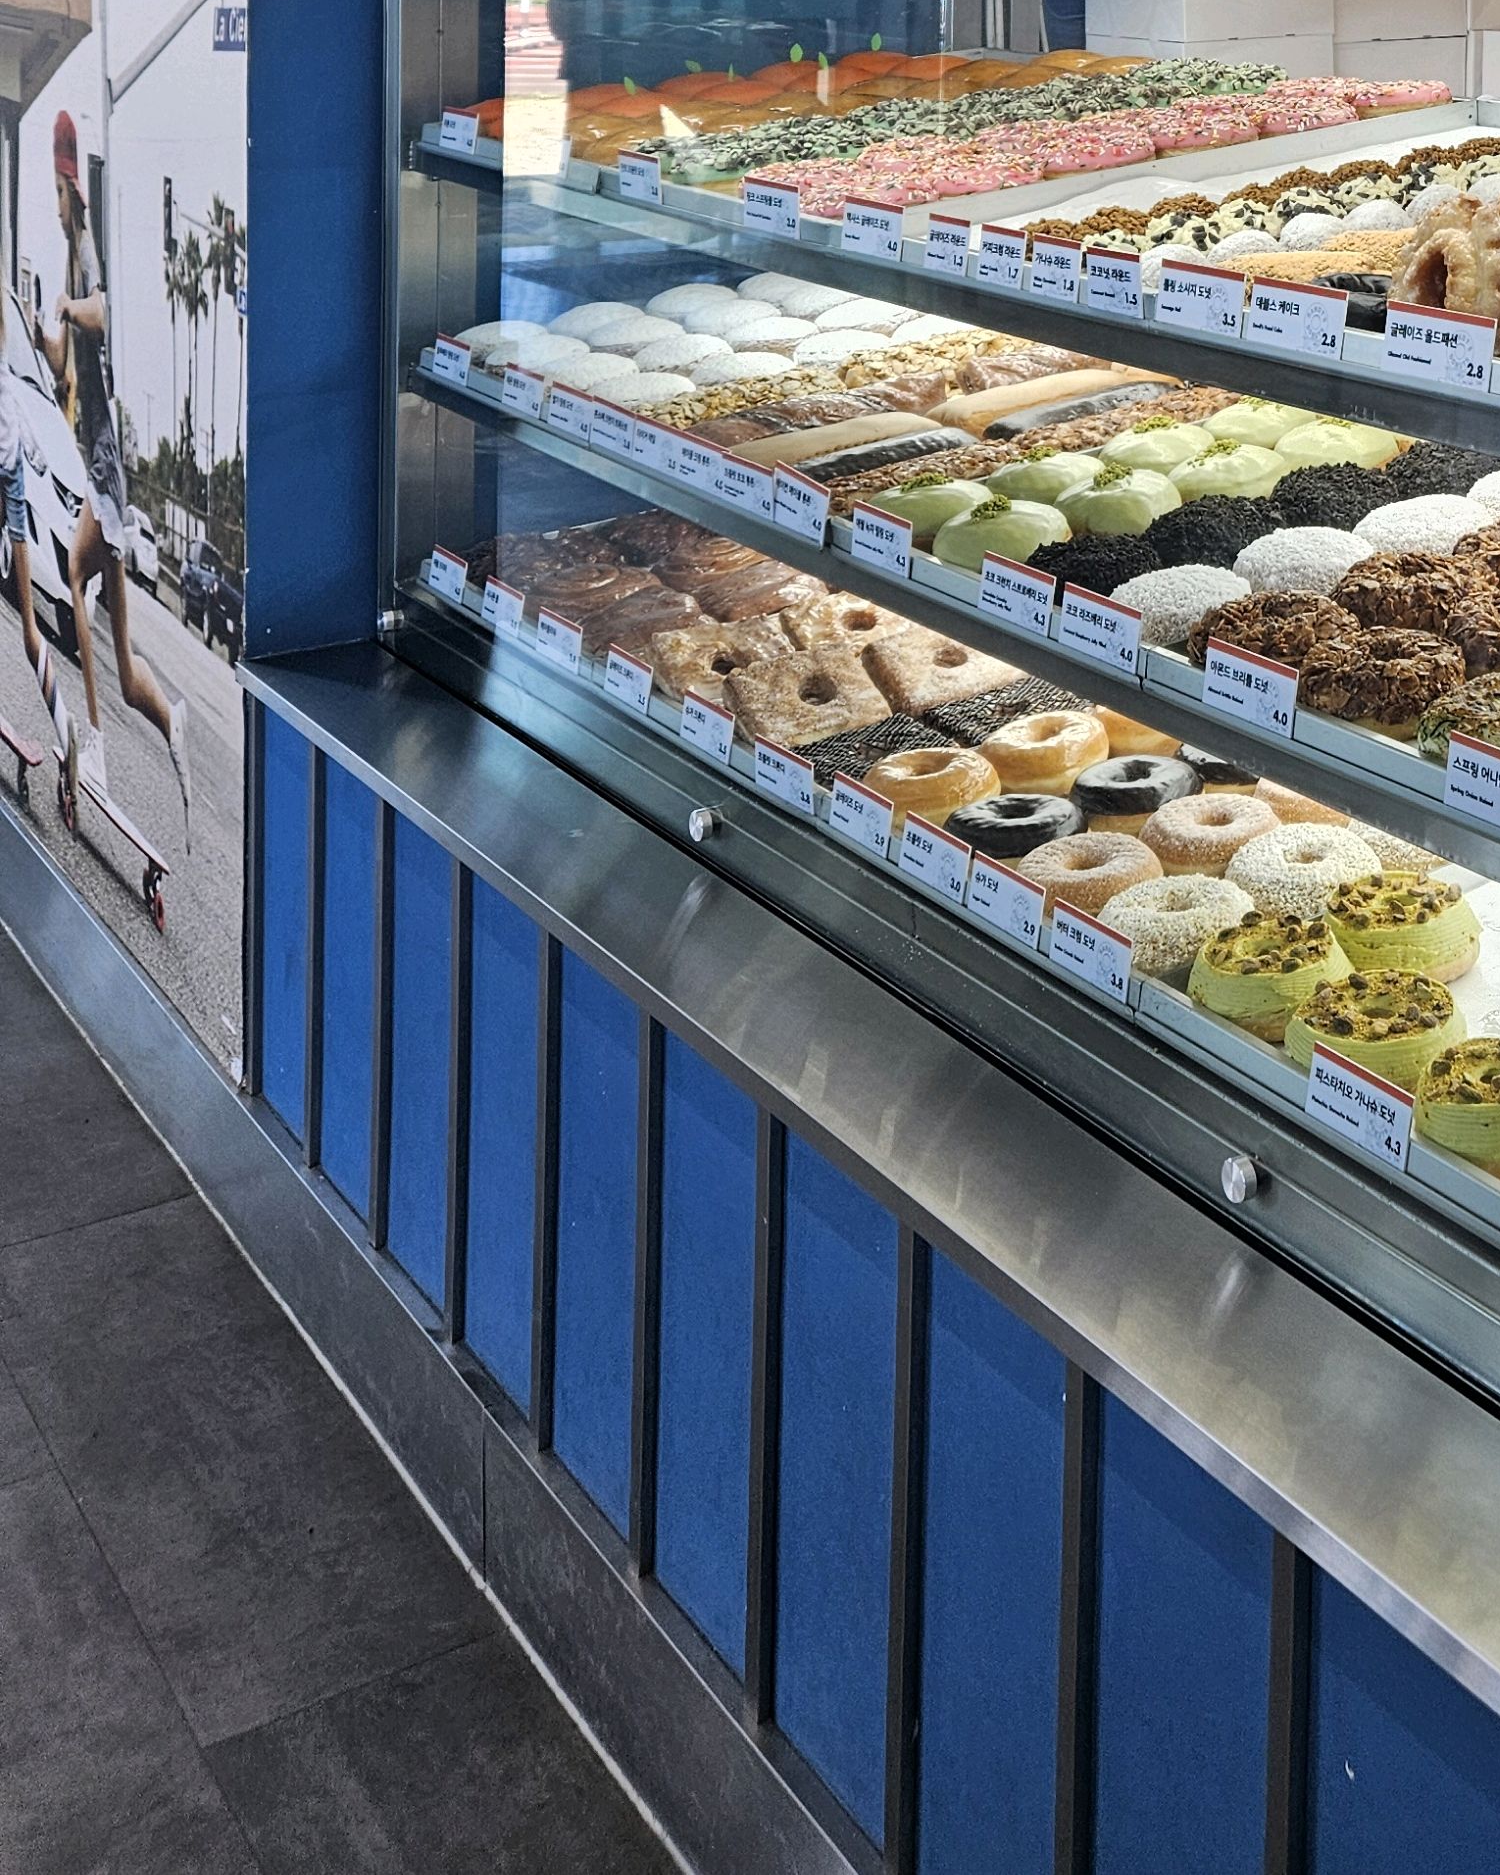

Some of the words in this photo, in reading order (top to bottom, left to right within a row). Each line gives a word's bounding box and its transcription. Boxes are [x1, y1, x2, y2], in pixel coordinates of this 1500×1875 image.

[950, 234, 966, 247] 라운드
[1004, 247, 1021, 259] 라운드
[1035, 252, 1054, 267] 가나슈
[1054, 256, 1071, 270] 라운드
[1090, 265, 1110, 280] 코코넛
[1111, 268, 1131, 283] 라운드
[1124, 292, 1138, 306] 1.5
[1177, 281, 1197, 297] 소시지
[1198, 285, 1212, 300] 도넛
[1255, 296, 1277, 312] 데블스
[1277, 300, 1300, 317] 케이크
[1222, 312, 1236, 328] 3.5
[1321, 333, 1336, 348] 2.8
[1390, 322, 1424, 341] 글레이즈
[1424, 329, 1458, 349] 올드패션
[1466, 362, 1484, 380] 2.8
[1036, 592, 1049, 606] 도넛
[1033, 612, 1046, 626] 4.3
[1065, 603, 1078, 618] 코코
[1078, 608, 1104, 629] 라즈베리
[1103, 618, 1117, 634] 도넛
[1120, 647, 1133, 663] 4.0
[1210, 660, 1231, 678] 아몬드
[1253, 677, 1269, 695] 도넛
[1273, 709, 1288, 726] 4.0
[1452, 756, 1479, 779] 스프링
[853, 800, 864, 815] 도넛
[873, 832, 885, 848] 2.9
[906, 830, 923, 850] 초콜릿
[922, 842, 934, 856] 도넛
[949, 877, 961, 893] 3.0
[975, 871, 988, 888] 슈가
[987, 879, 999, 895] 도넛
[1023, 919, 1036, 936] 2.9
[1056, 919, 1070, 938] 버터
[1069, 926, 1082, 944] 크럼
[1082, 934, 1096, 952] 도넛
[1110, 972, 1124, 991] 3.8
[1314, 1066, 1353, 1101] 피스타치오
[1354, 1087, 1378, 1116] 가나슈
[1378, 1104, 1396, 1127] 도넛
[1384, 1135, 1402, 1157] 4.3
